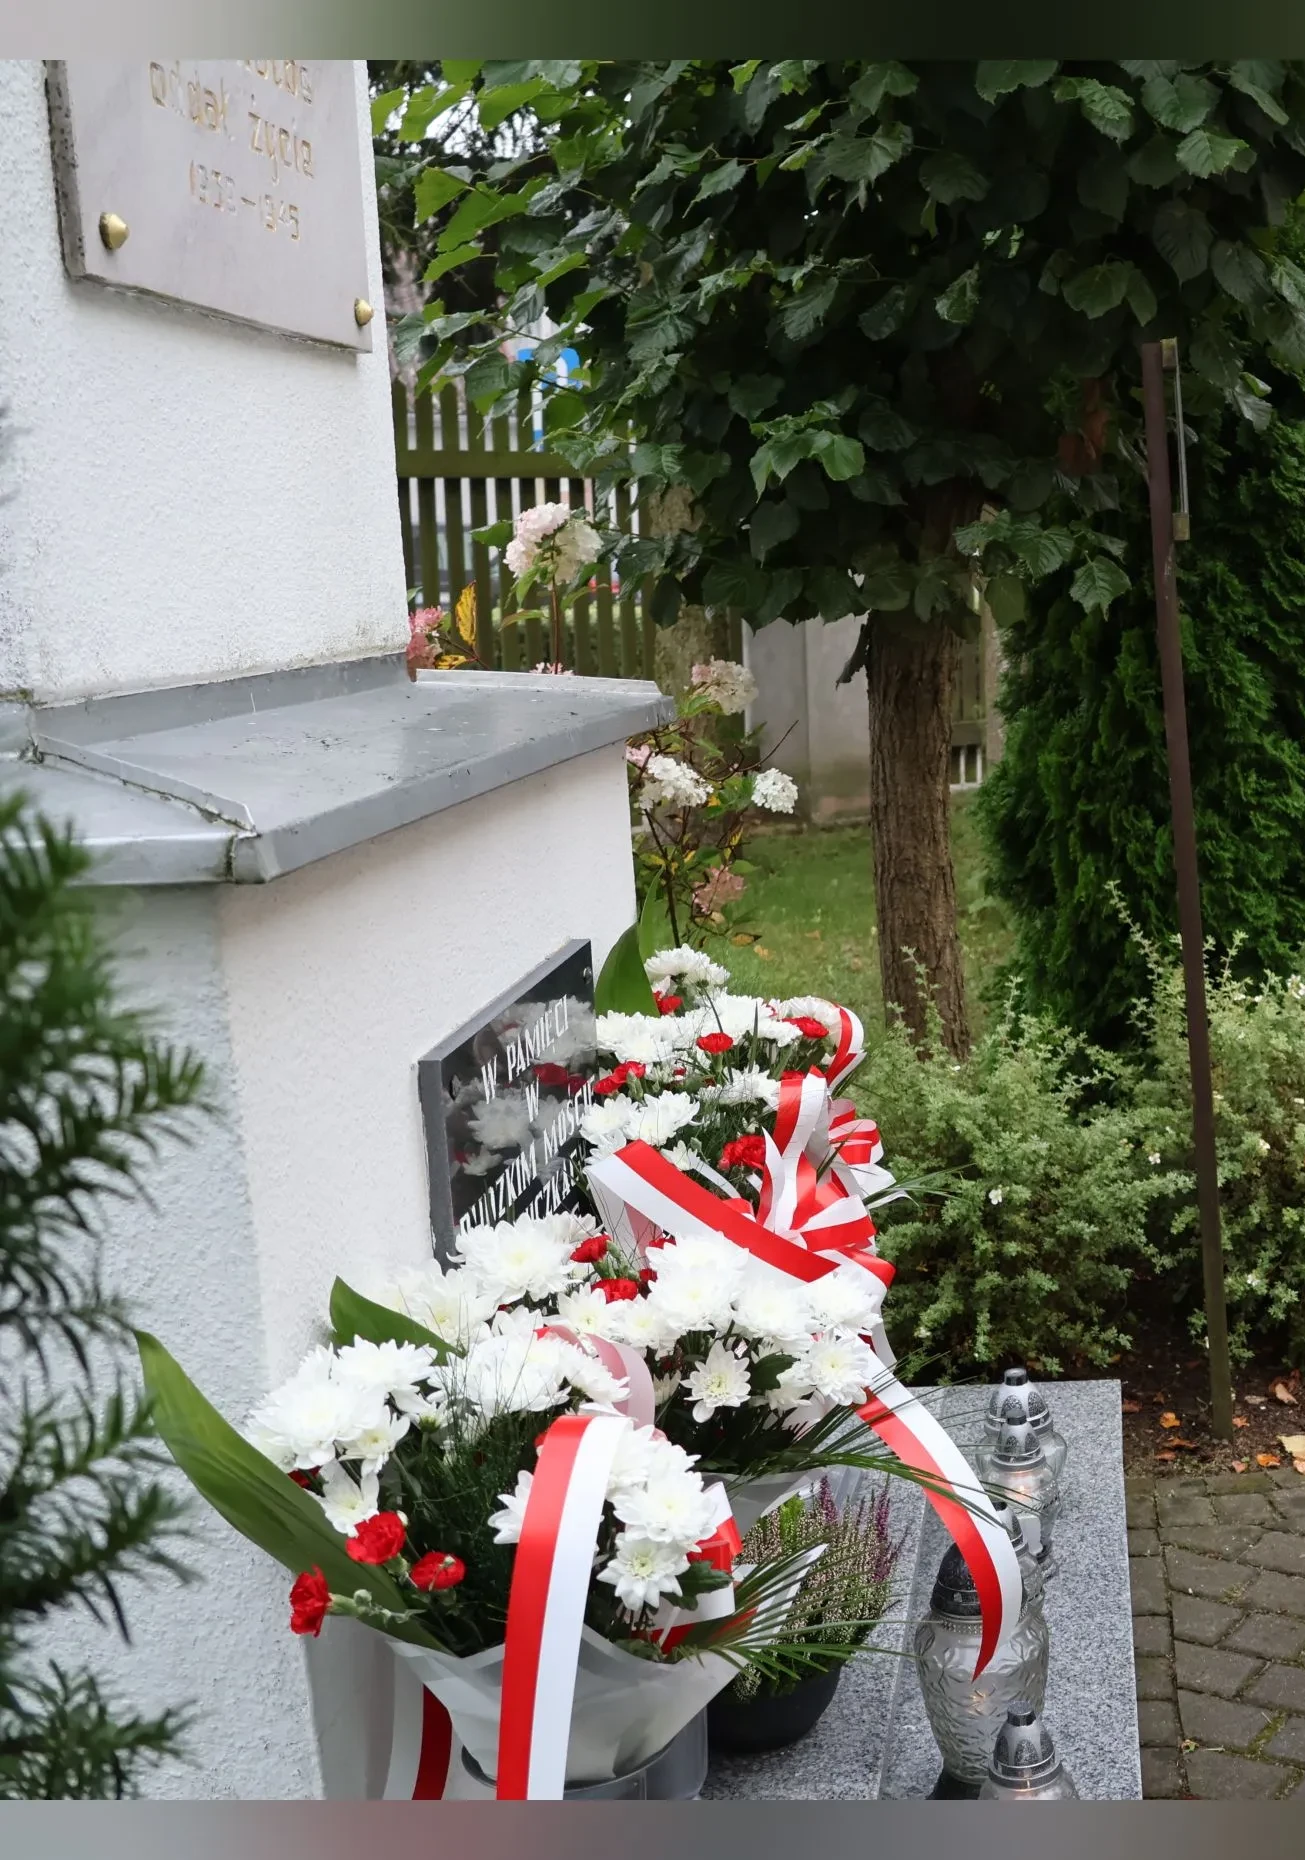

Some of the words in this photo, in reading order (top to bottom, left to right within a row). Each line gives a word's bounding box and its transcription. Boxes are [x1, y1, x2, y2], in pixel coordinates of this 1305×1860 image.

[481, 1053, 498, 1104] W
[506, 994, 568, 1084] PAMIĘCI
[525, 1073, 539, 1122] W
